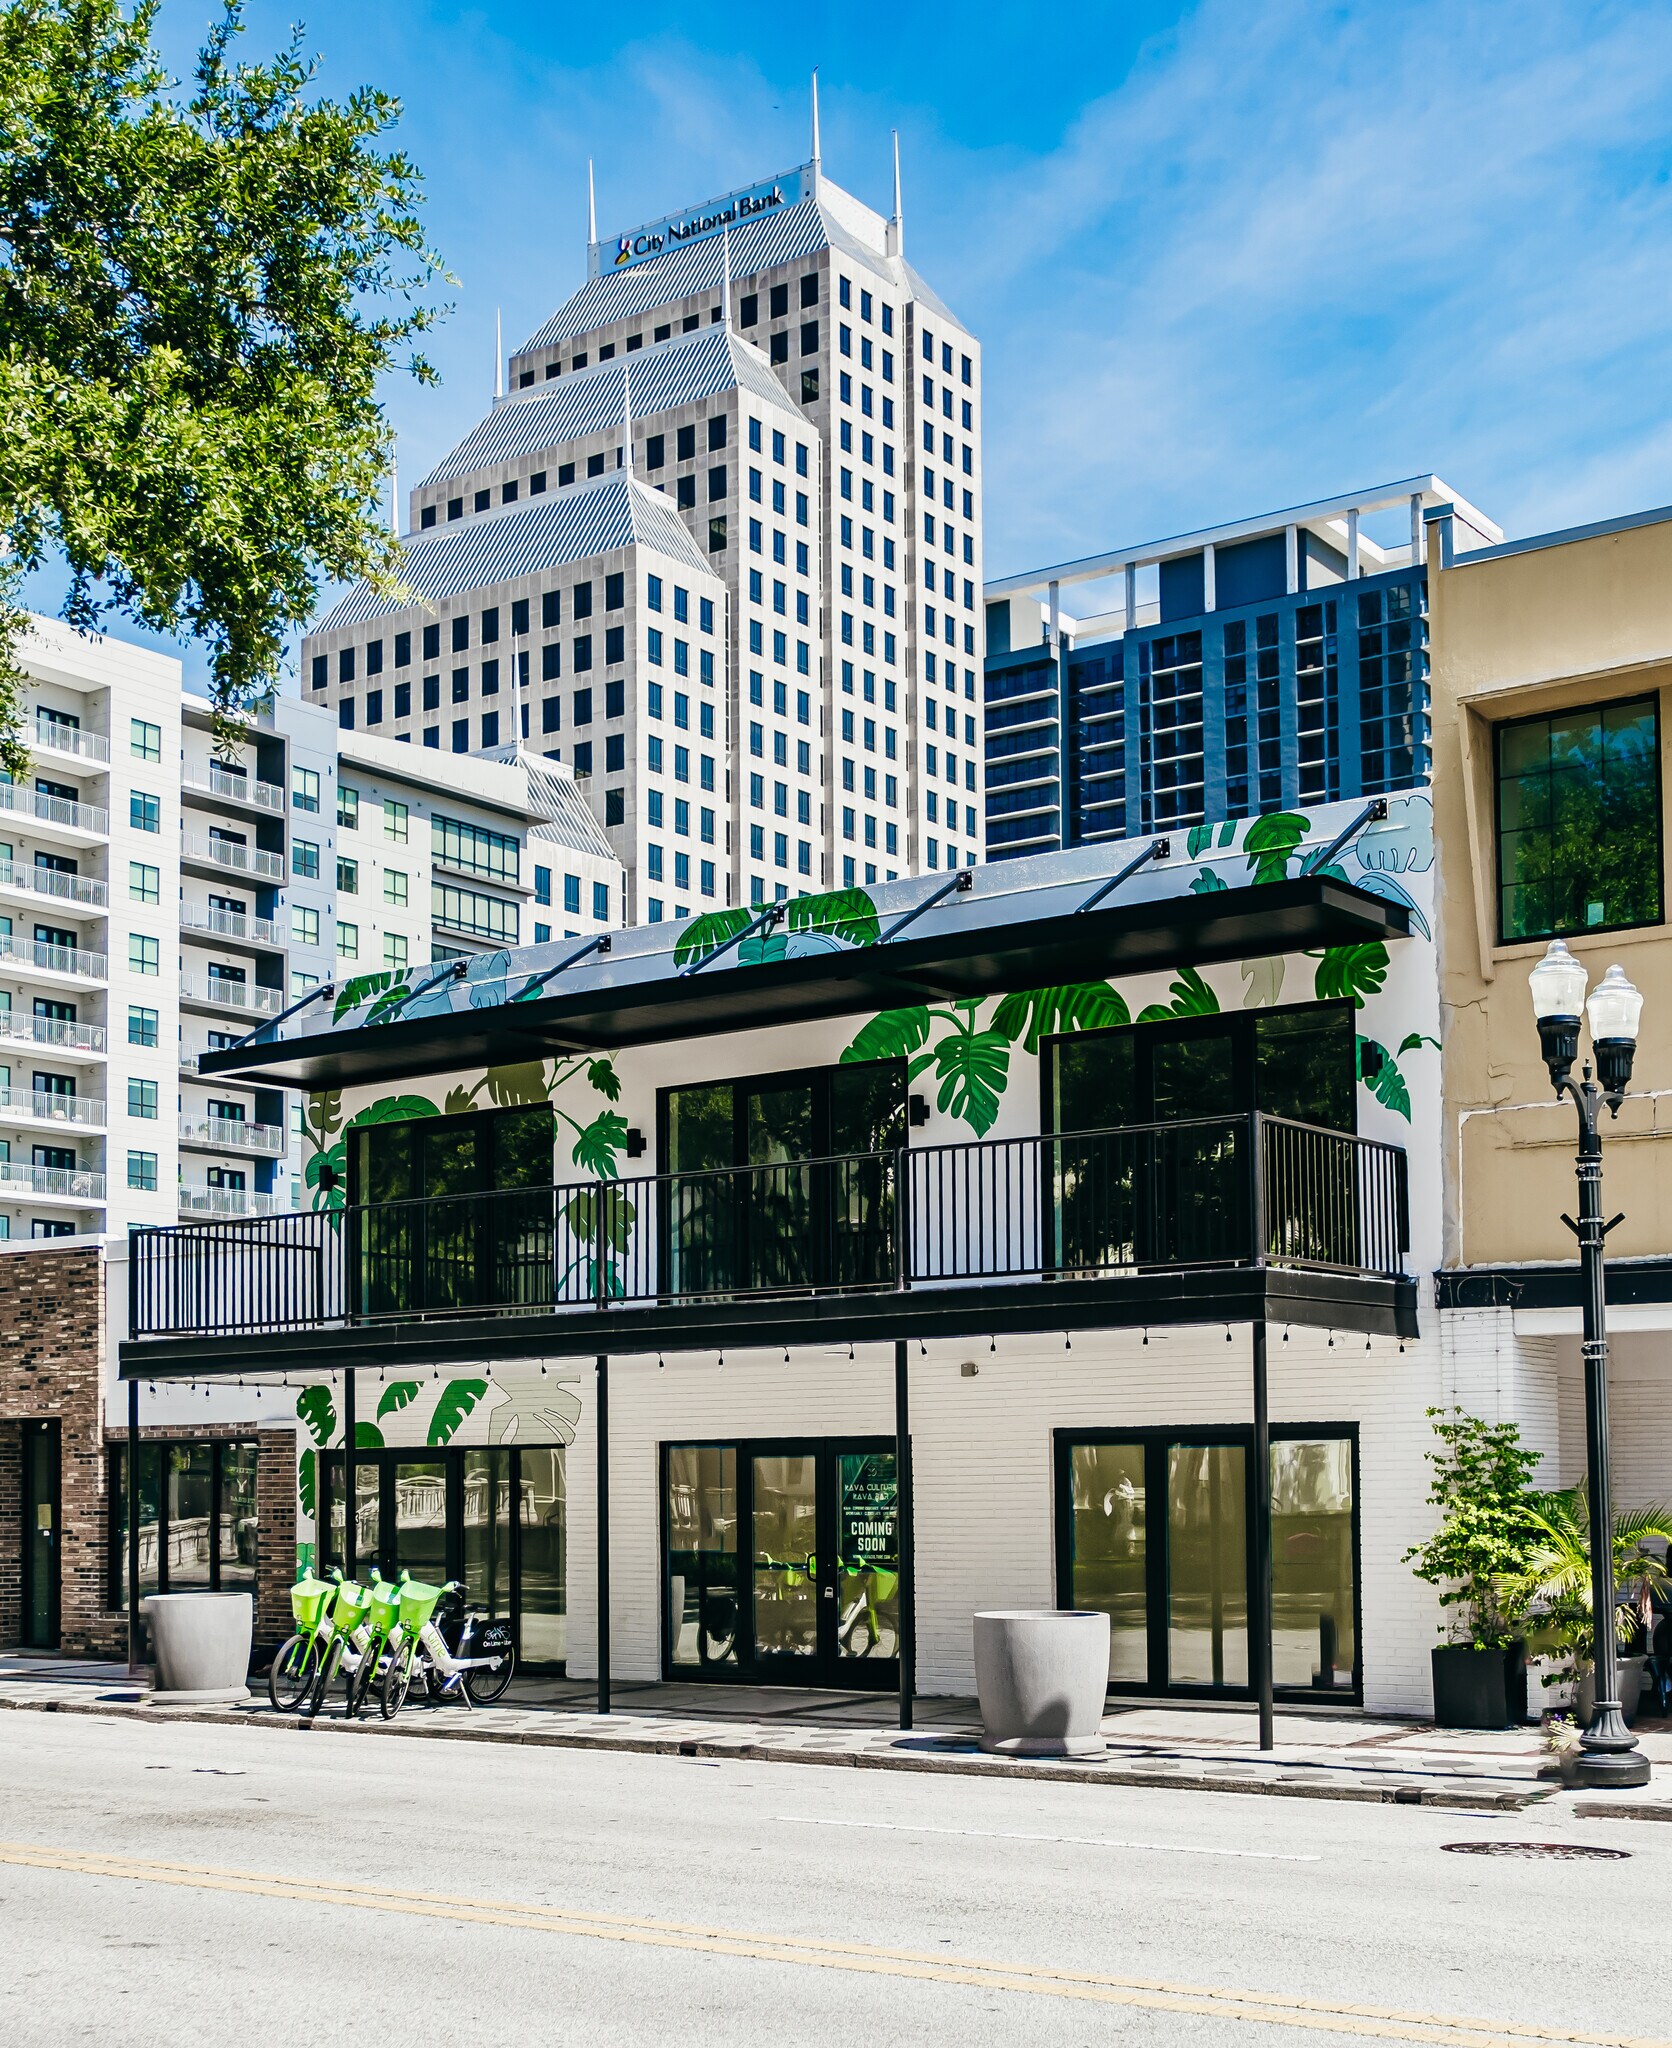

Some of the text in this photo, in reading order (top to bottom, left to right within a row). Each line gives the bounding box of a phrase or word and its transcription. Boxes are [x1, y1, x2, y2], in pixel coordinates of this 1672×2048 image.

[634, 186, 784, 255] City National Bank
[851, 1521, 892, 1535] COMING
[858, 1537, 886, 1551] SOON
[427, 1630, 447, 1658] Lime
